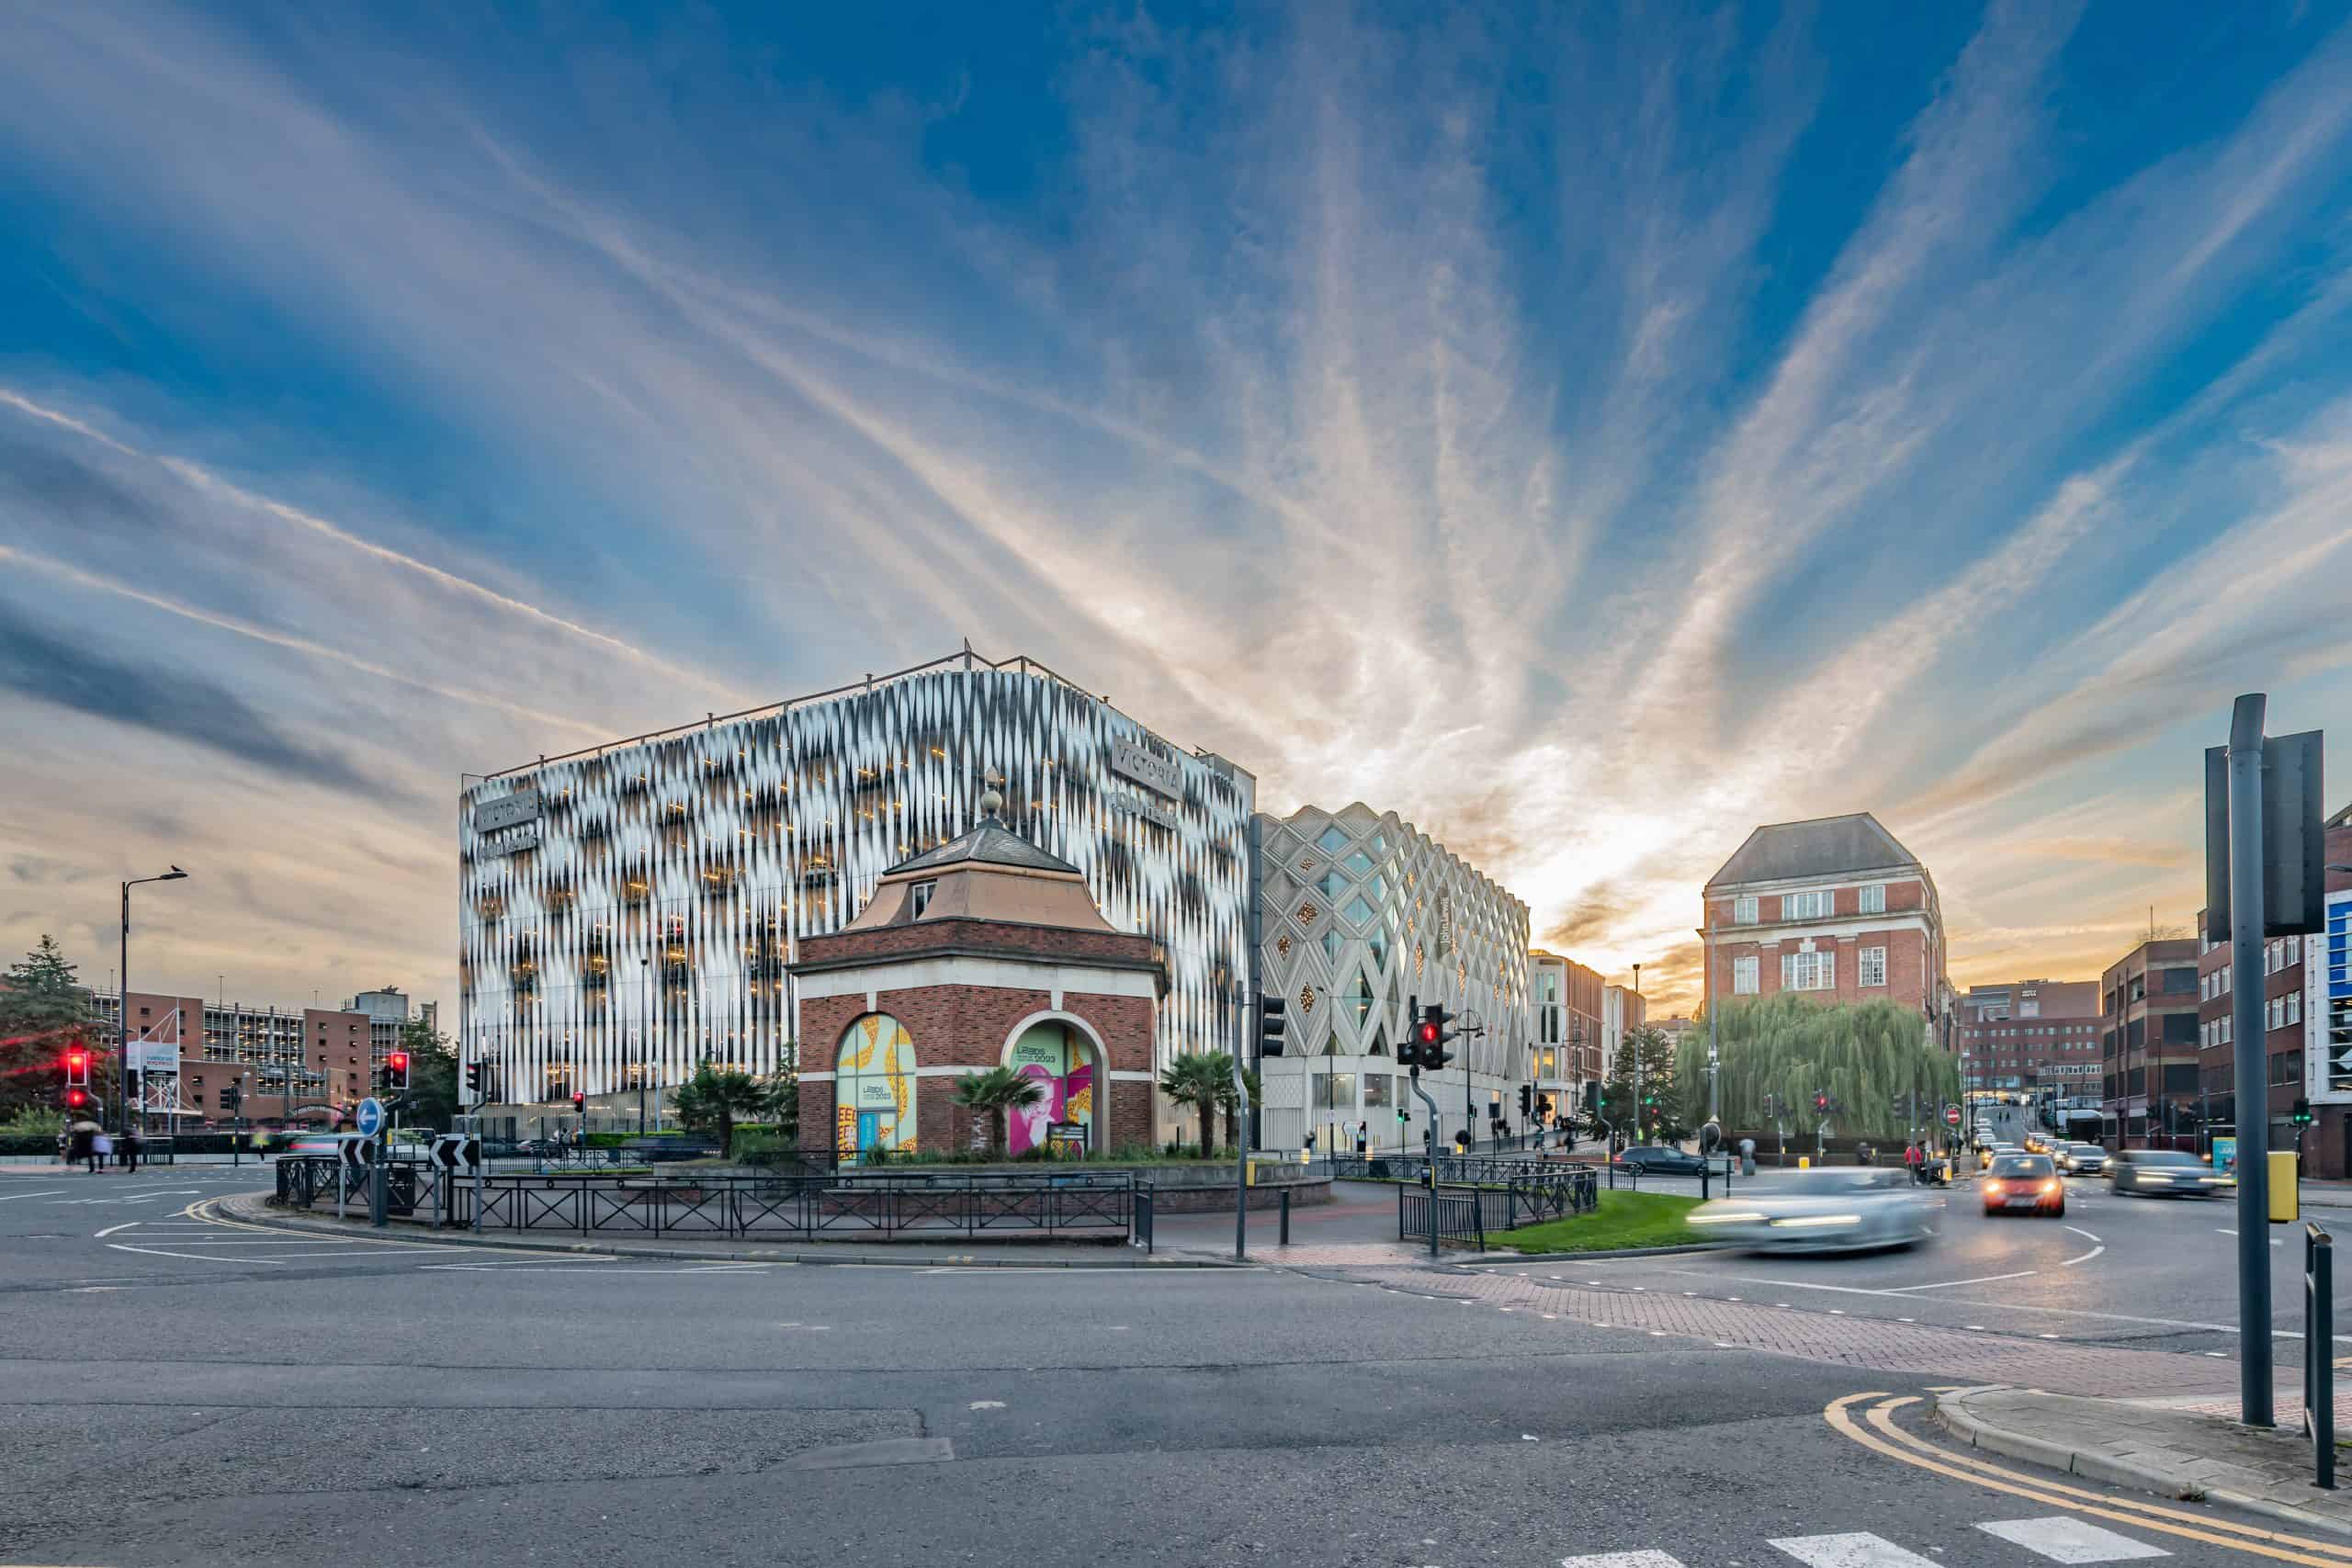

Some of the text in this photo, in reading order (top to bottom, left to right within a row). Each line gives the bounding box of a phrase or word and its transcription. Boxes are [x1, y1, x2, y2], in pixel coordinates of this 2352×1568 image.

[1117, 744, 1177, 788] VICTORIA
[481, 796, 534, 824] VICTORIA
[1440, 897, 1450, 944] John Lewis
